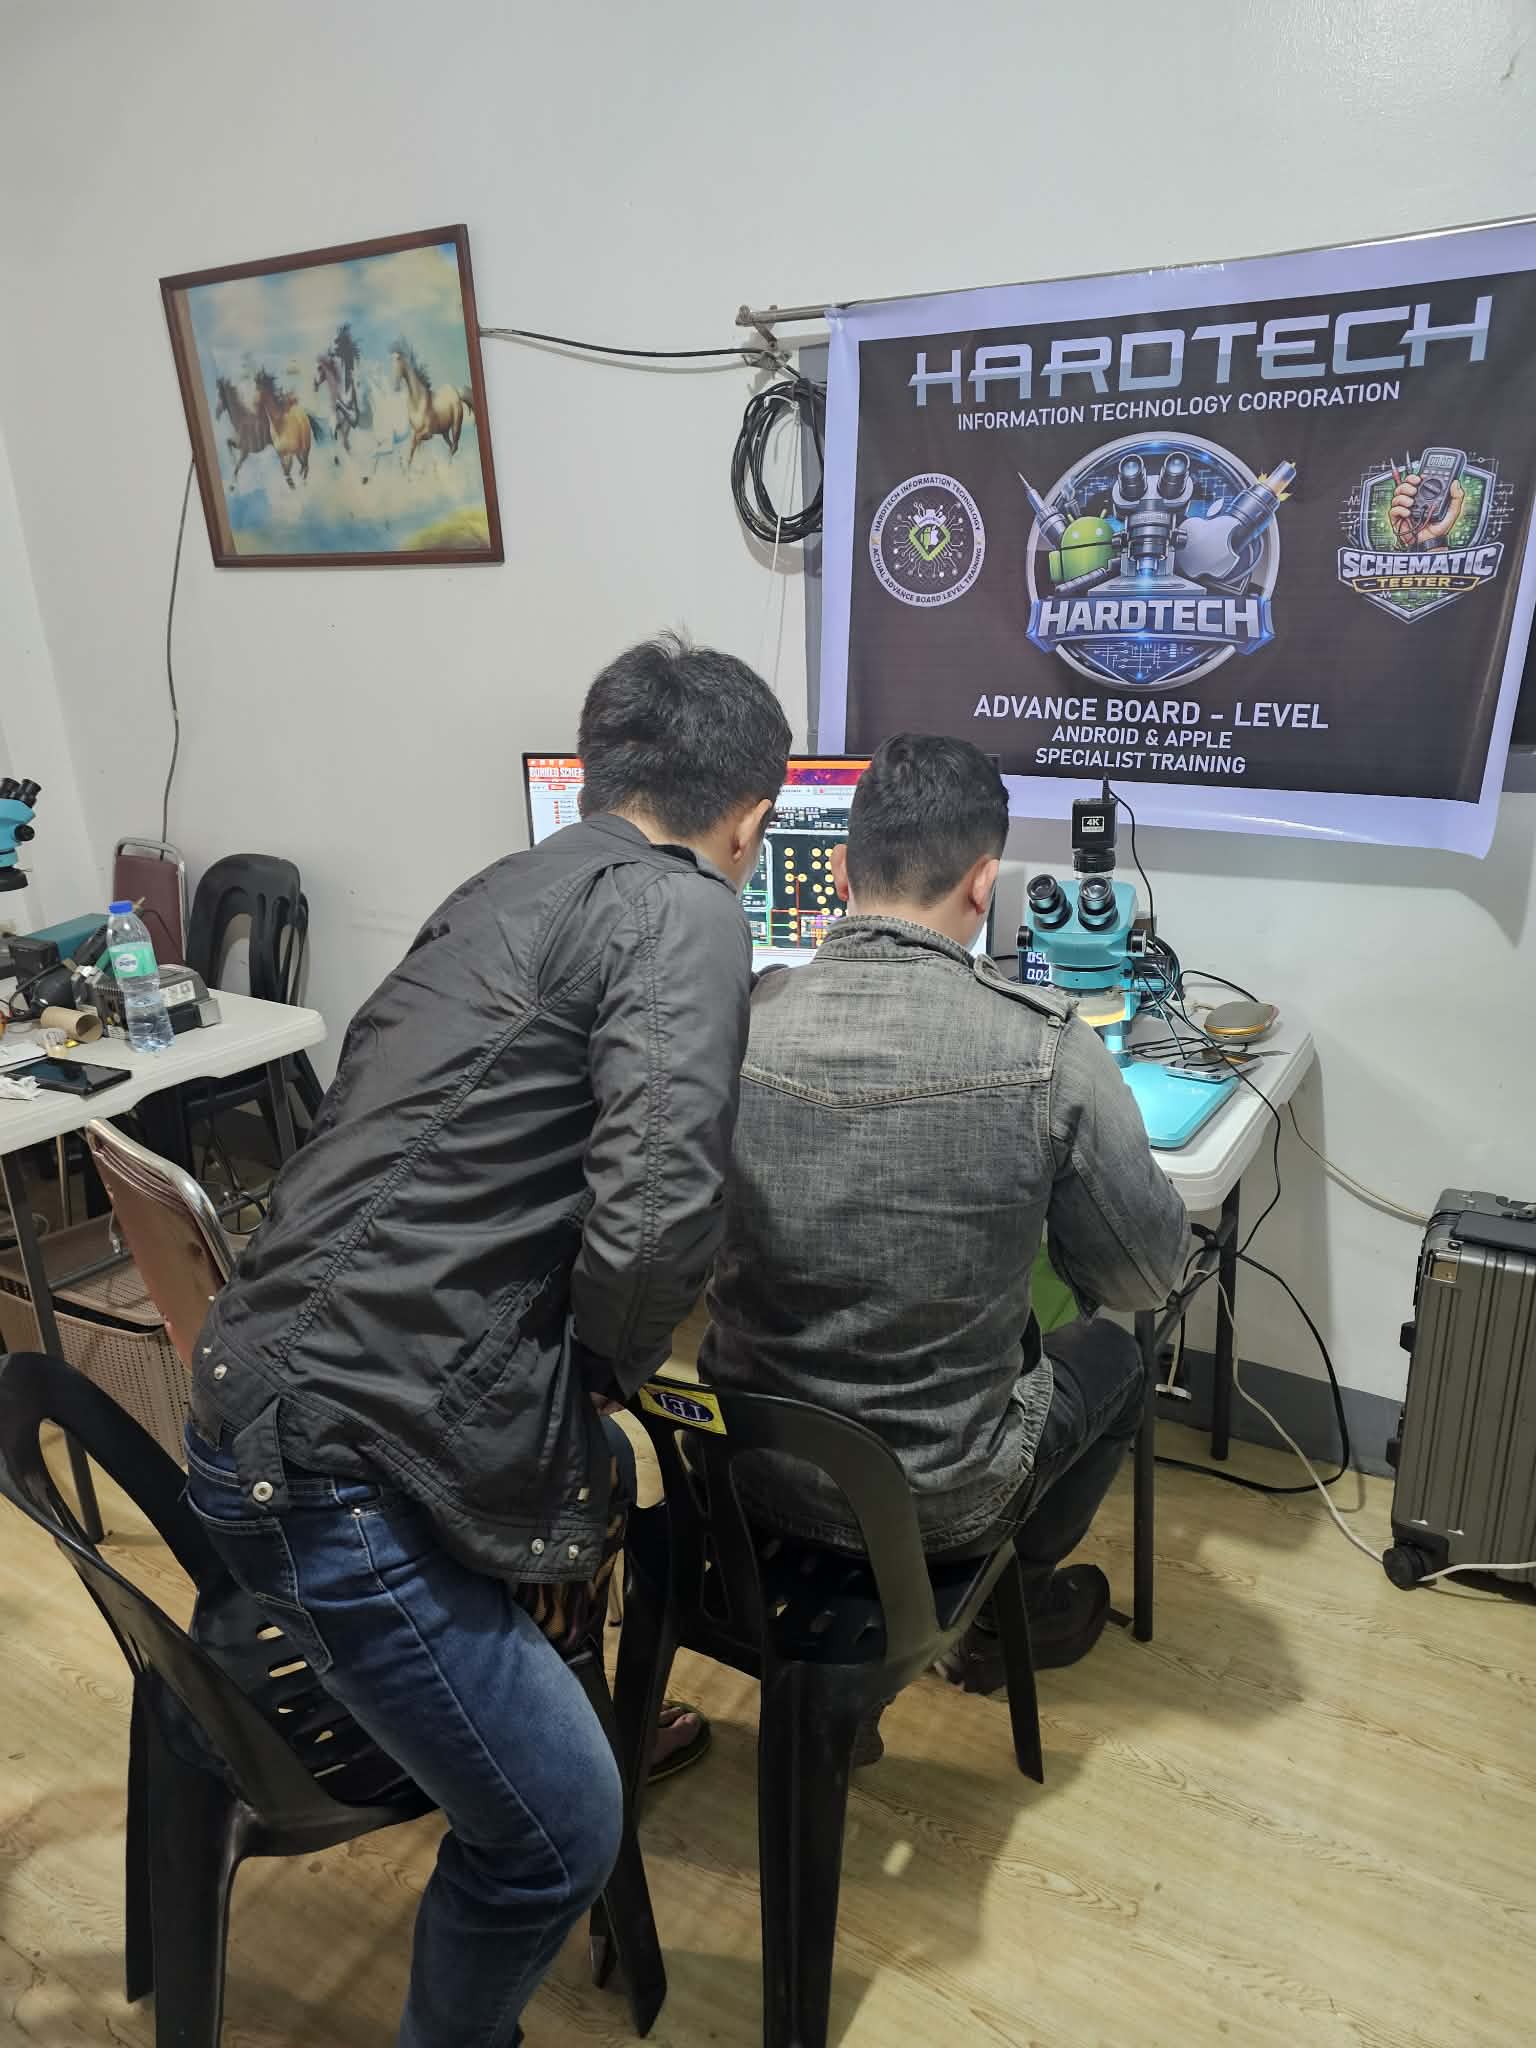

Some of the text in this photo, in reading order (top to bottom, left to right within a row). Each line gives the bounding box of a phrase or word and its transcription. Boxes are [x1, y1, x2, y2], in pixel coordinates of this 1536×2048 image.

[908, 296, 1493, 407] HARDTECH
[957, 381, 1400, 431] INFORMATION TECHNOLOGY CORPORATION
[900, 476, 953, 495] INFORMATION
[872, 547, 888, 578] ACTUAL
[885, 578, 915, 601] ADVANCE
[942, 583, 966, 600] LEVEL
[1342, 547, 1497, 578] SCHEMATIC
[1376, 577, 1452, 588] TESTER
[1038, 600, 1261, 638] HARDTECH
[973, 694, 1098, 722] ADVANCE
[1105, 699, 1201, 725] BOARD
[1234, 702, 1330, 730] LEVEL
[1051, 725, 1233, 749] ANDROID & APPLE
[1034, 747, 1247, 775] SPECIALIST TRAINING
[1086, 818, 1101, 827] 4K
